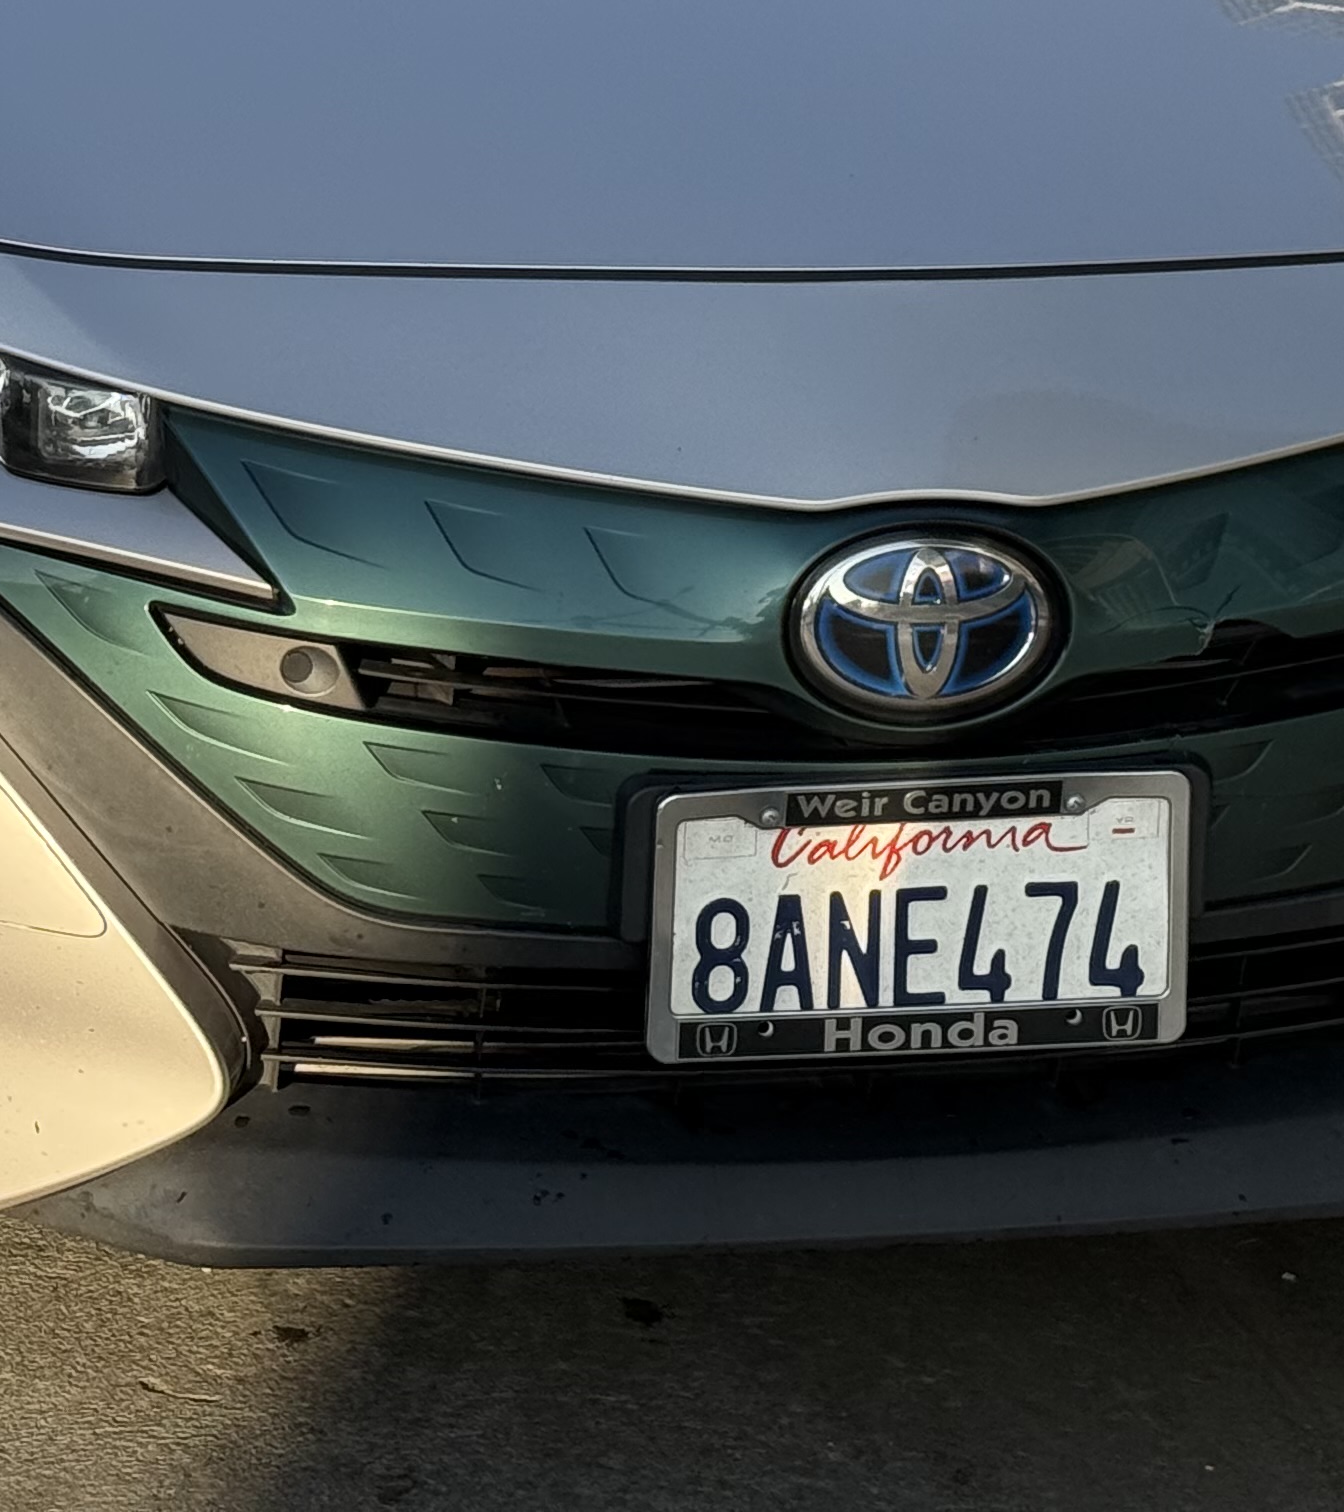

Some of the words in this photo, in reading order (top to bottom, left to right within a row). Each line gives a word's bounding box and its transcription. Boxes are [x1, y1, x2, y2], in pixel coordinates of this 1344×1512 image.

[797, 792, 889, 819] Weir
[904, 789, 1051, 816] Canyon
[771, 821, 1089, 881] California
[692, 881, 1145, 1014] 8ANE474
[824, 1013, 1019, 1052] Honda
